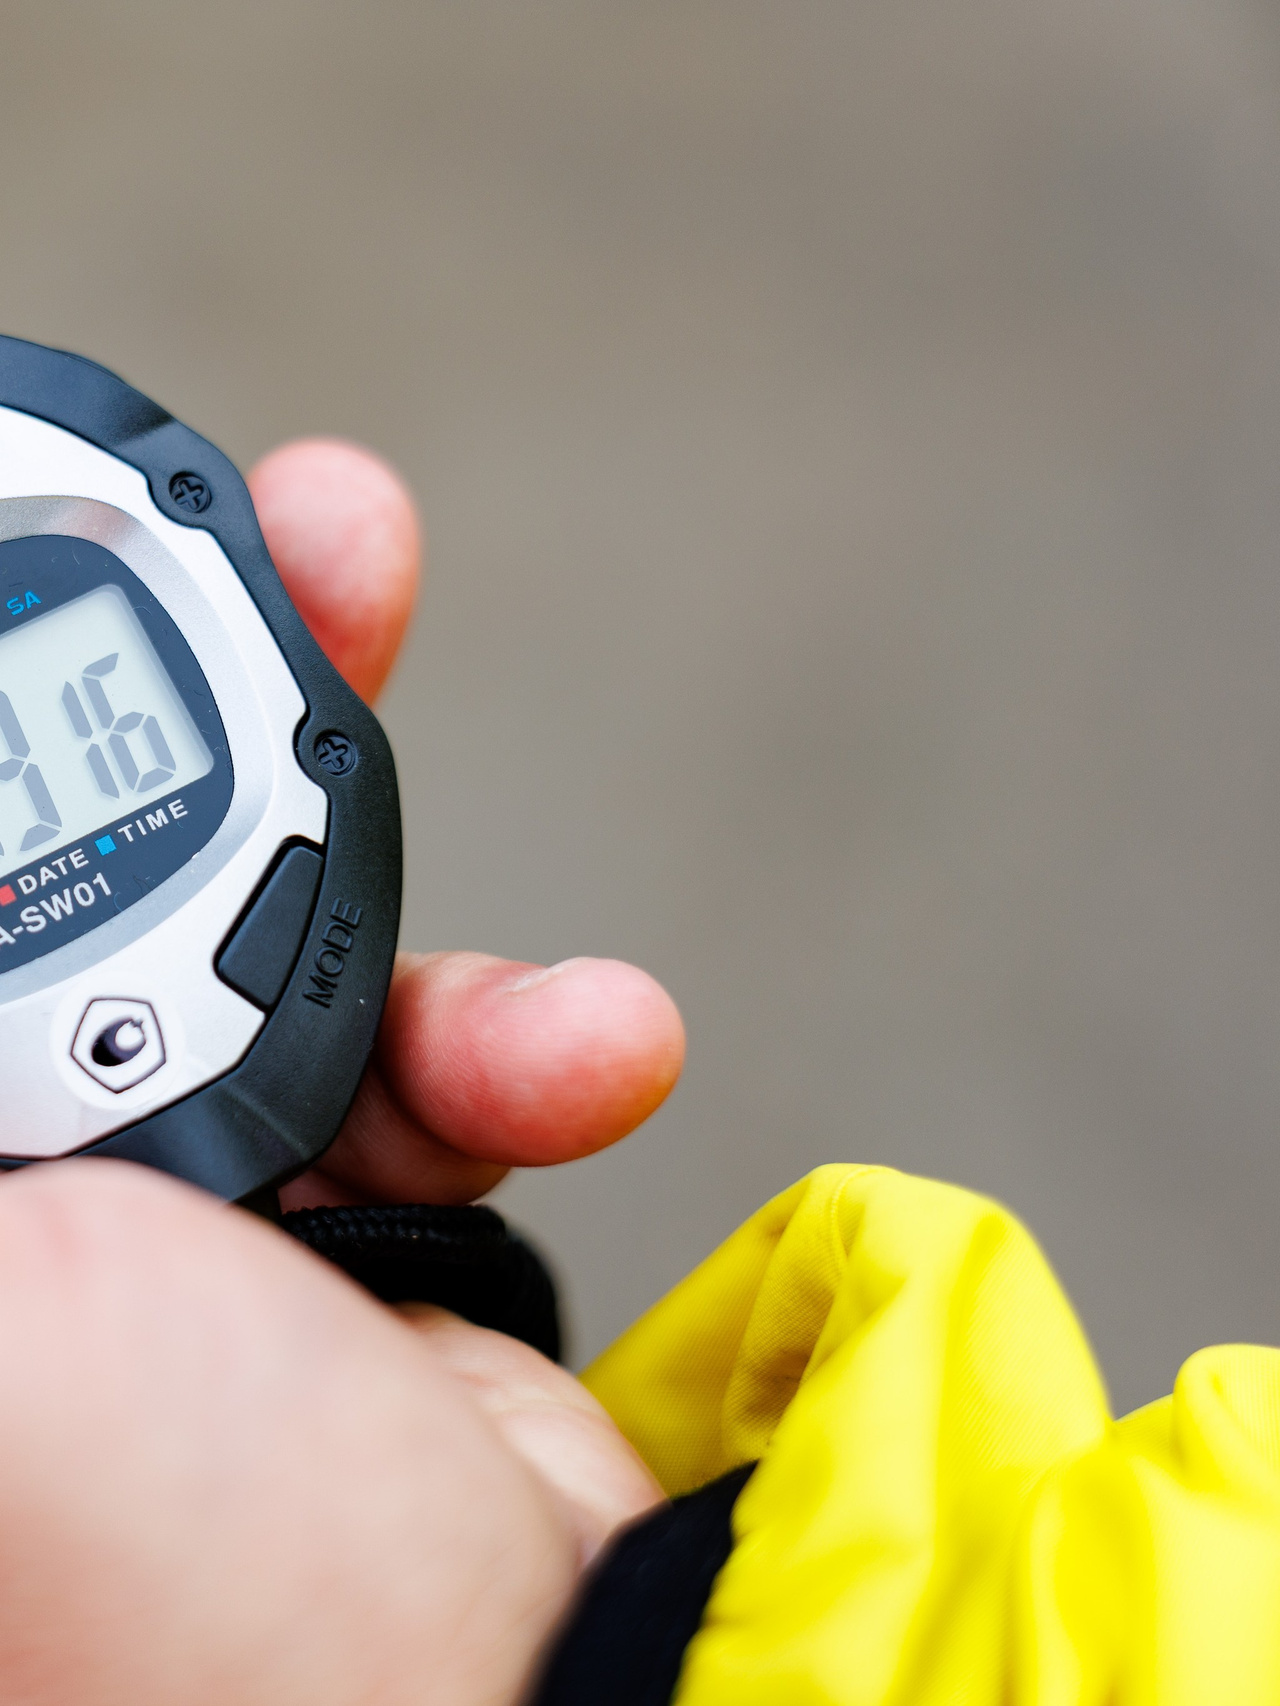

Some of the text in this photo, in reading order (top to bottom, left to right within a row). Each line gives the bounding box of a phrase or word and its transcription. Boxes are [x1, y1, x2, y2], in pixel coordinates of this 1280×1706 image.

[6, 590, 42, 616] SA
[17, 848, 90, 895] DATE
[117, 798, 189, 843] TIME
[302, 897, 363, 1009] MODE
